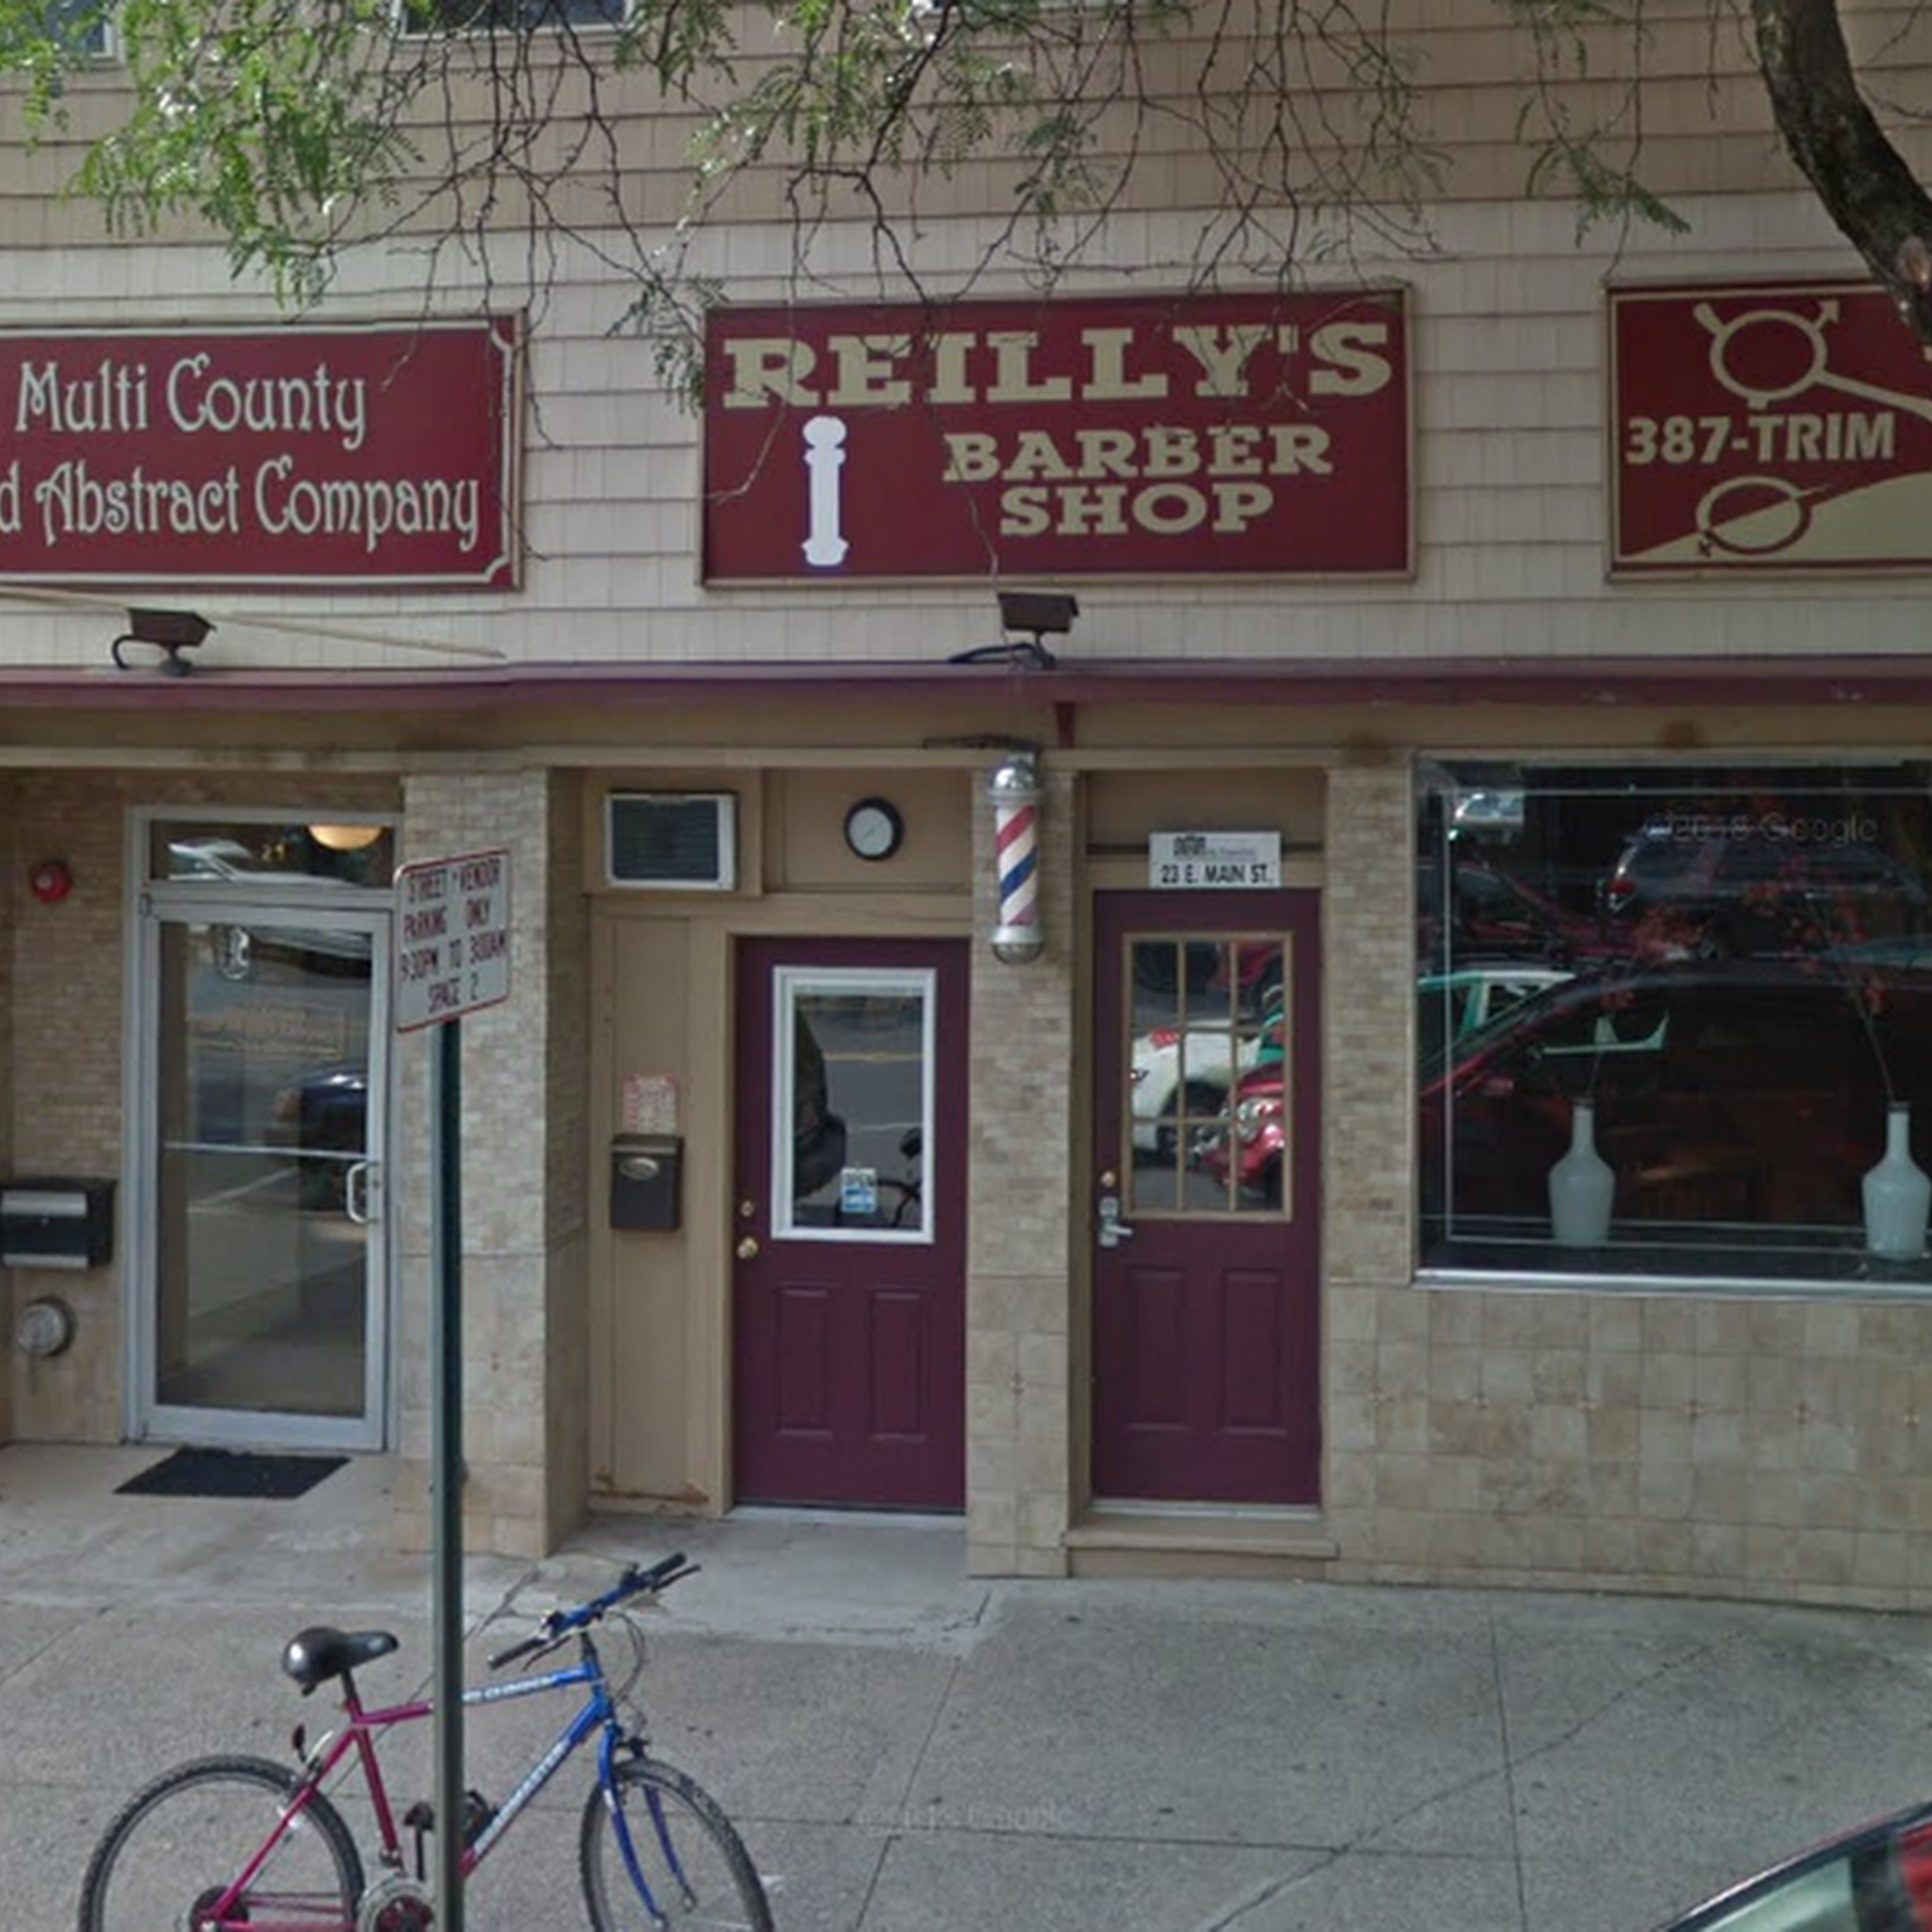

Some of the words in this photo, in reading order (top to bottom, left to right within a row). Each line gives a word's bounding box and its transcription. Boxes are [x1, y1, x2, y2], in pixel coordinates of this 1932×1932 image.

[723, 322, 1393, 410] REILLY'S
[14, 360, 149, 432] Multi
[166, 353, 366, 451] County
[943, 424, 1333, 482] BARBER
[1625, 412, 1895, 465] 387-TRIM
[35, 461, 240, 548] Abstract
[254, 455, 479, 554] Company
[1000, 482, 1274, 537] SHOP
[460, 857, 501, 893] VENDOR
[1161, 864, 1179, 884] 23
[1205, 864, 1246, 884] MAIN
[404, 905, 446, 943] PARKING
[466, 896, 491, 930] ONLY
[449, 938, 462, 969] TO
[429, 977, 461, 1013] SPACE
[470, 971, 479, 1002] 2
